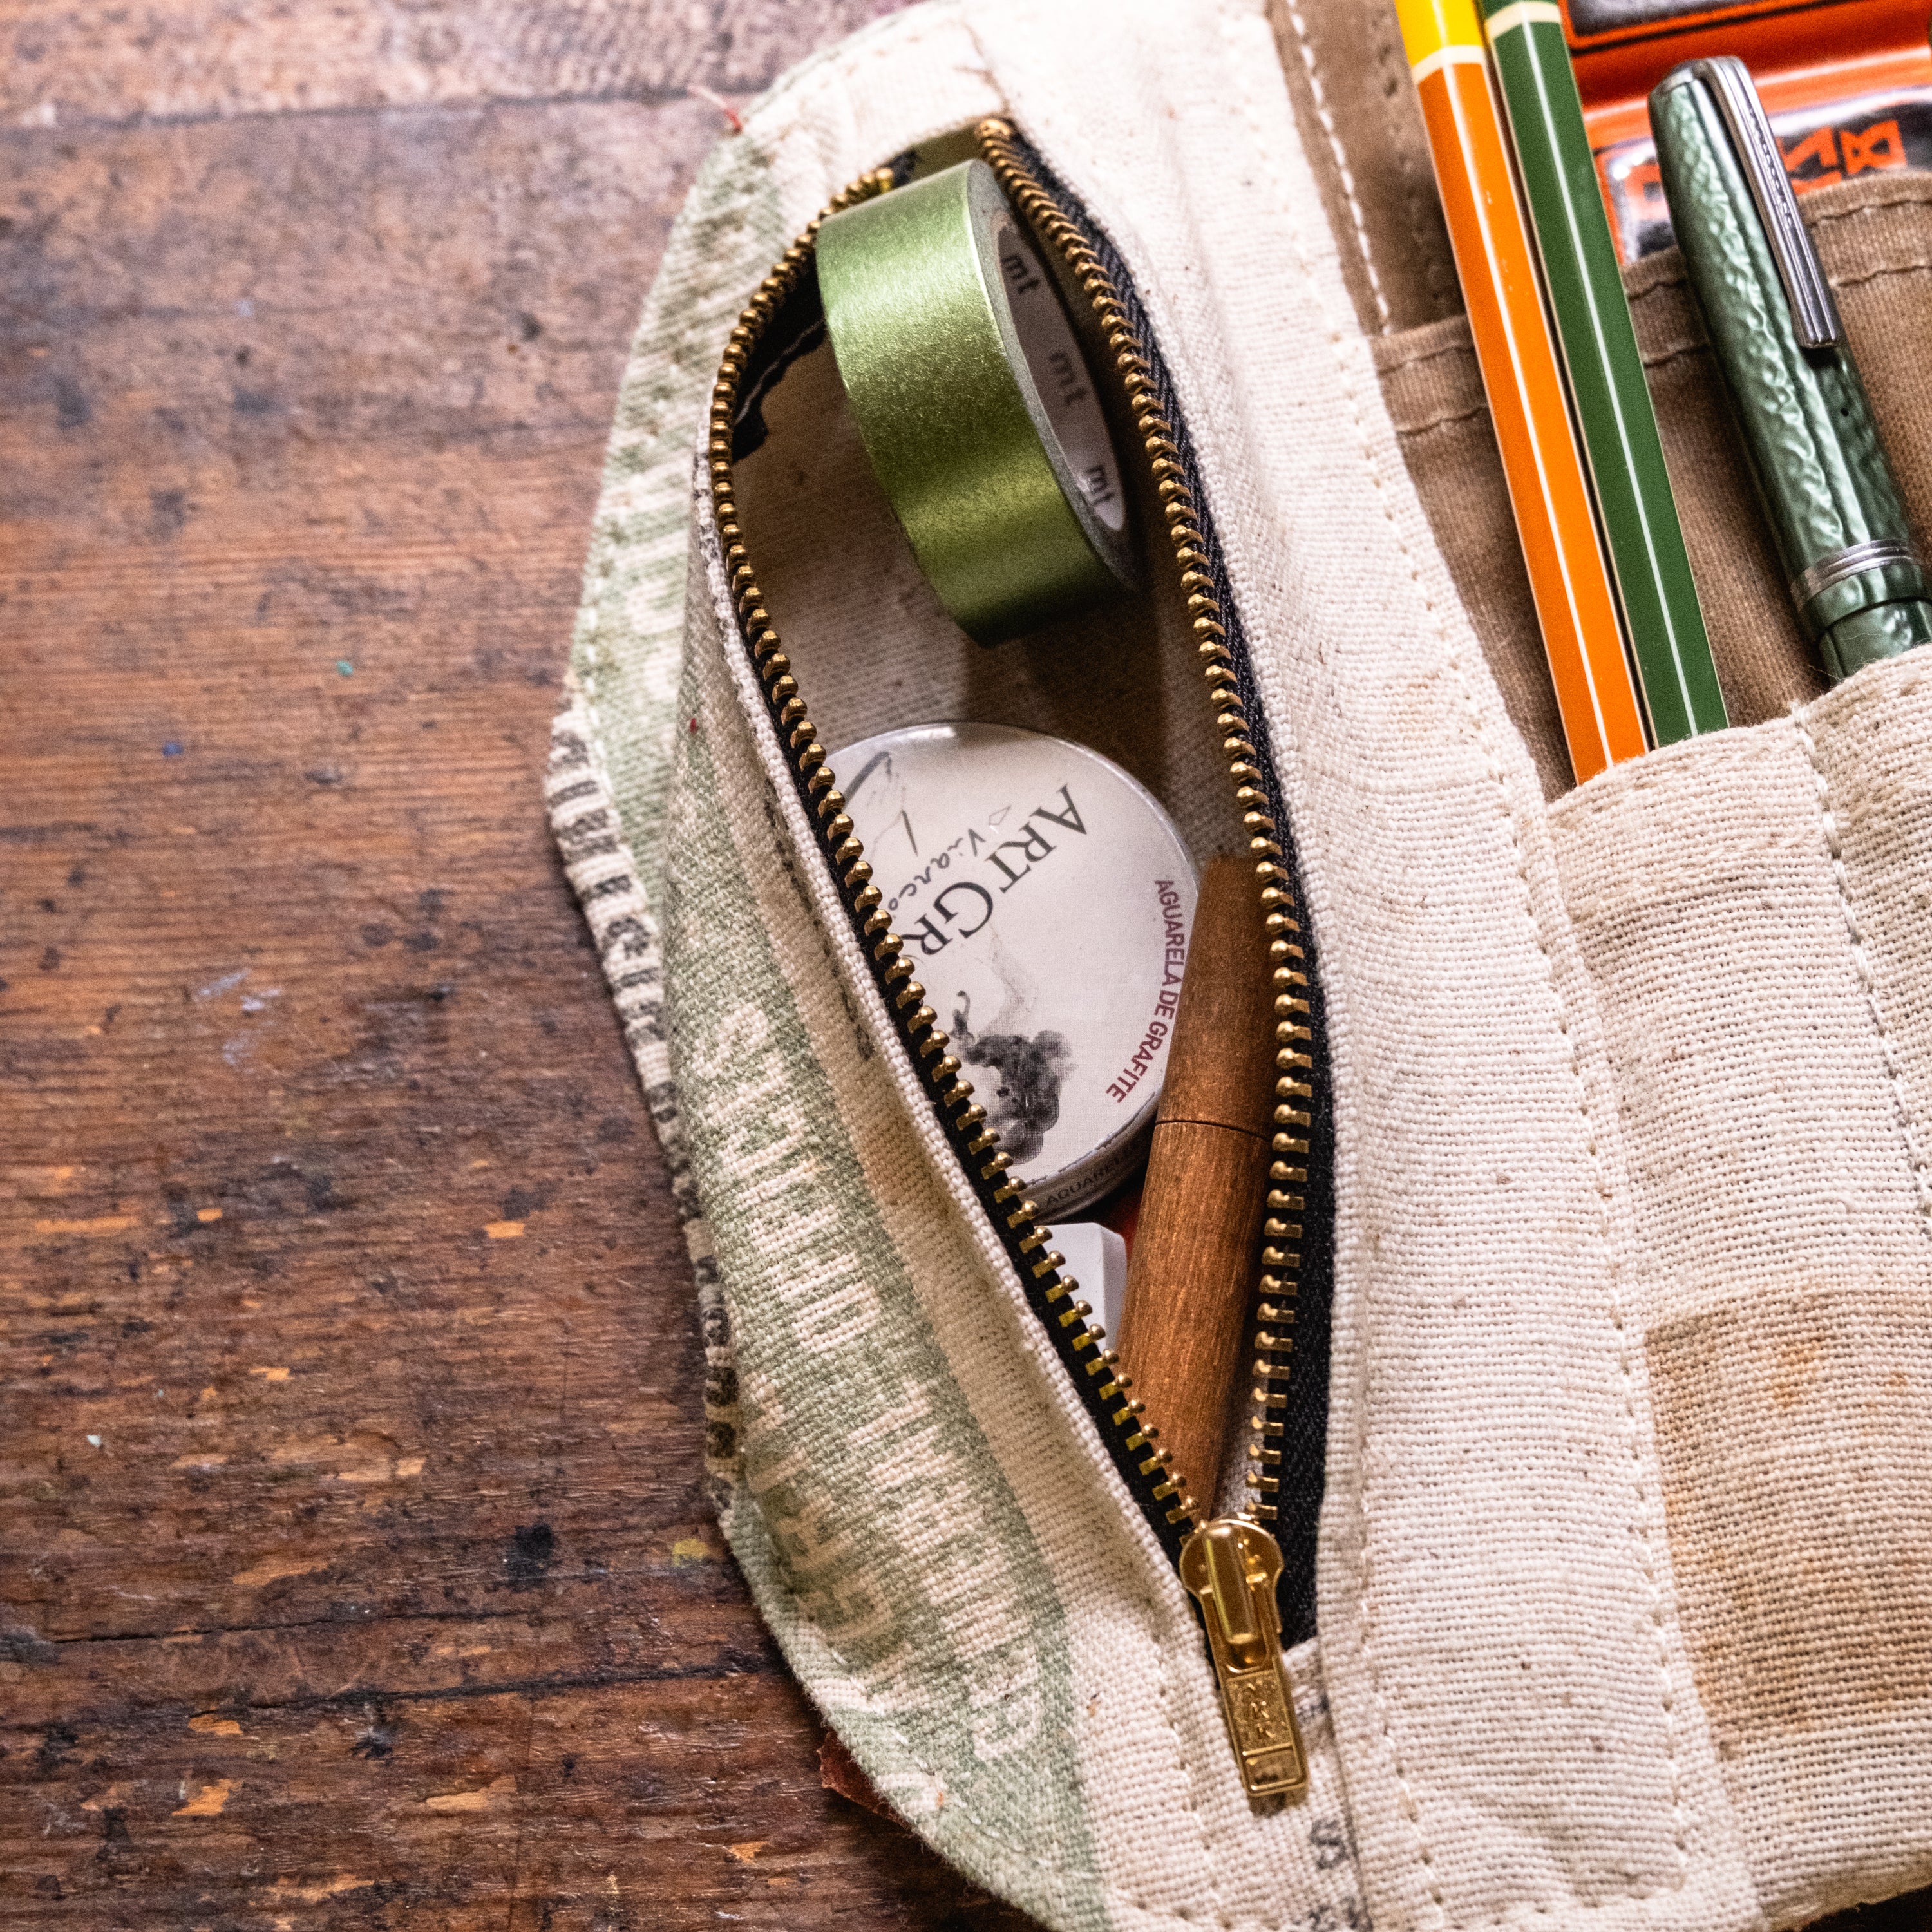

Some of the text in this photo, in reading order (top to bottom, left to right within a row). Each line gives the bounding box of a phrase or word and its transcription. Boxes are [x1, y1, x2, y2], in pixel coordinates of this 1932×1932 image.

[1002, 255, 1039, 294] mt
[1050, 351, 1086, 406] mt
[1088, 465, 1115, 504] mt
[888, 828, 986, 911] Viarco
[1106, 878, 1186, 1103] AGUARELA DE GRAFITE
